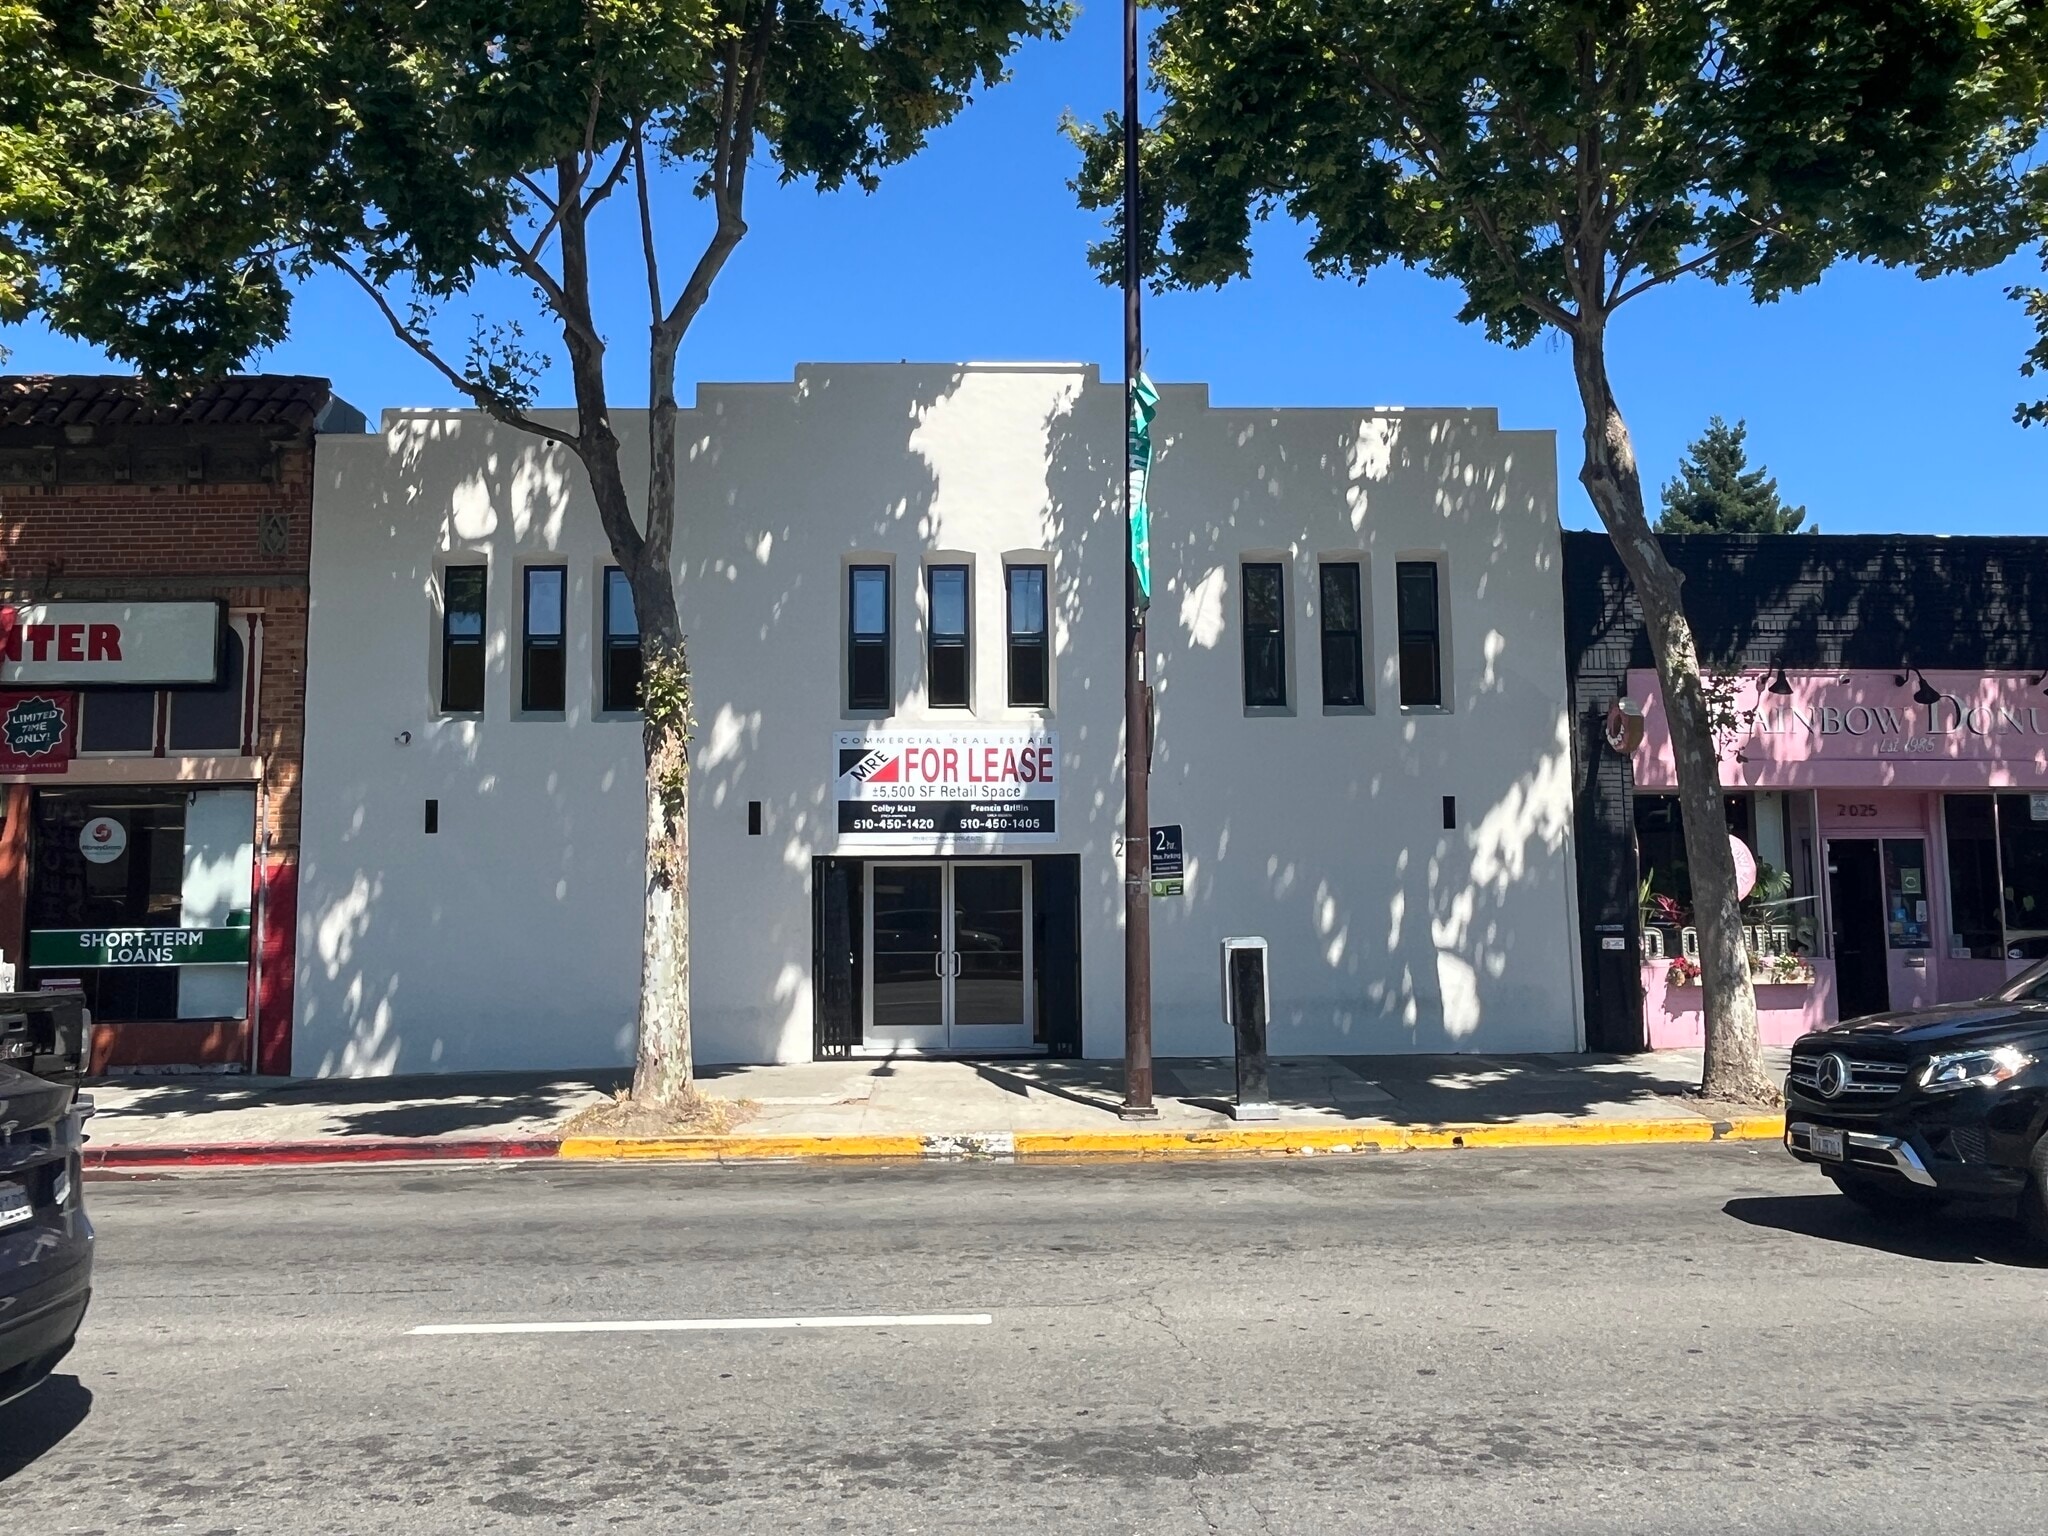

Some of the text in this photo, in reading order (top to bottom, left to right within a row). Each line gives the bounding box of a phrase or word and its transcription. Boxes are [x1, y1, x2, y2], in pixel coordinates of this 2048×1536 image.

[12, 710, 58, 724] LIMITED
[1738, 704, 1904, 736] AINBOW
[22, 722, 47, 733] TIME
[15, 733, 51, 744] ONLY!
[840, 736, 1053, 745] COMMERCIAL REAL ESTATE
[850, 749, 889, 782] MRE
[905, 747, 1054, 783] FOR LEASE
[919, 786, 937, 798] SF
[941, 785, 977, 798] Retail
[982, 785, 1021, 801] Space
[871, 804, 896, 815] Colby
[970, 803, 1001, 812] Francis
[1838, 804, 1878, 817] 2025
[853, 818, 934, 830] 510-450-1420
[959, 818, 1040, 830] 510-450-1405
[1156, 830, 1166, 851] 2
[79, 931, 204, 948] SHORT-TERM
[107, 948, 174, 963] LOANS
